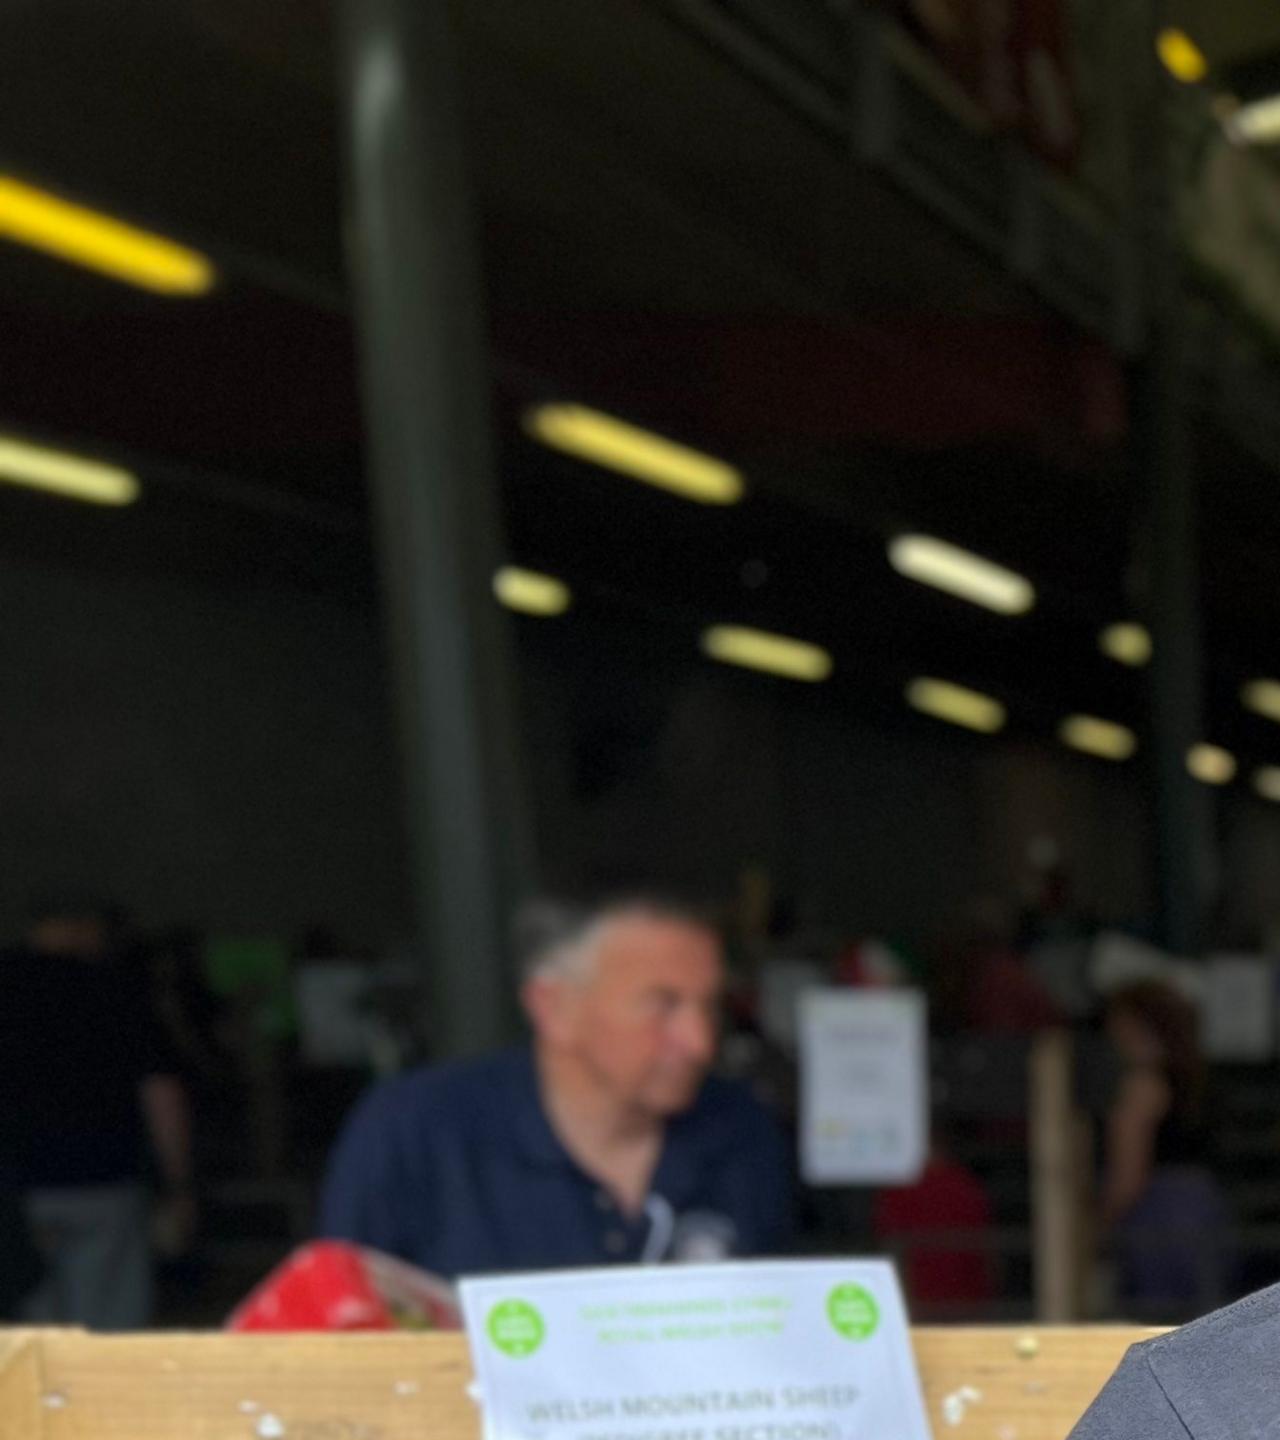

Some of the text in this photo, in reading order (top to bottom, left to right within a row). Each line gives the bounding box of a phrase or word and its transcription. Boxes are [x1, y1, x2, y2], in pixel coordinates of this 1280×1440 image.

[526, 1384, 861, 1424] WELSH MOUNTAIN SHEEP
